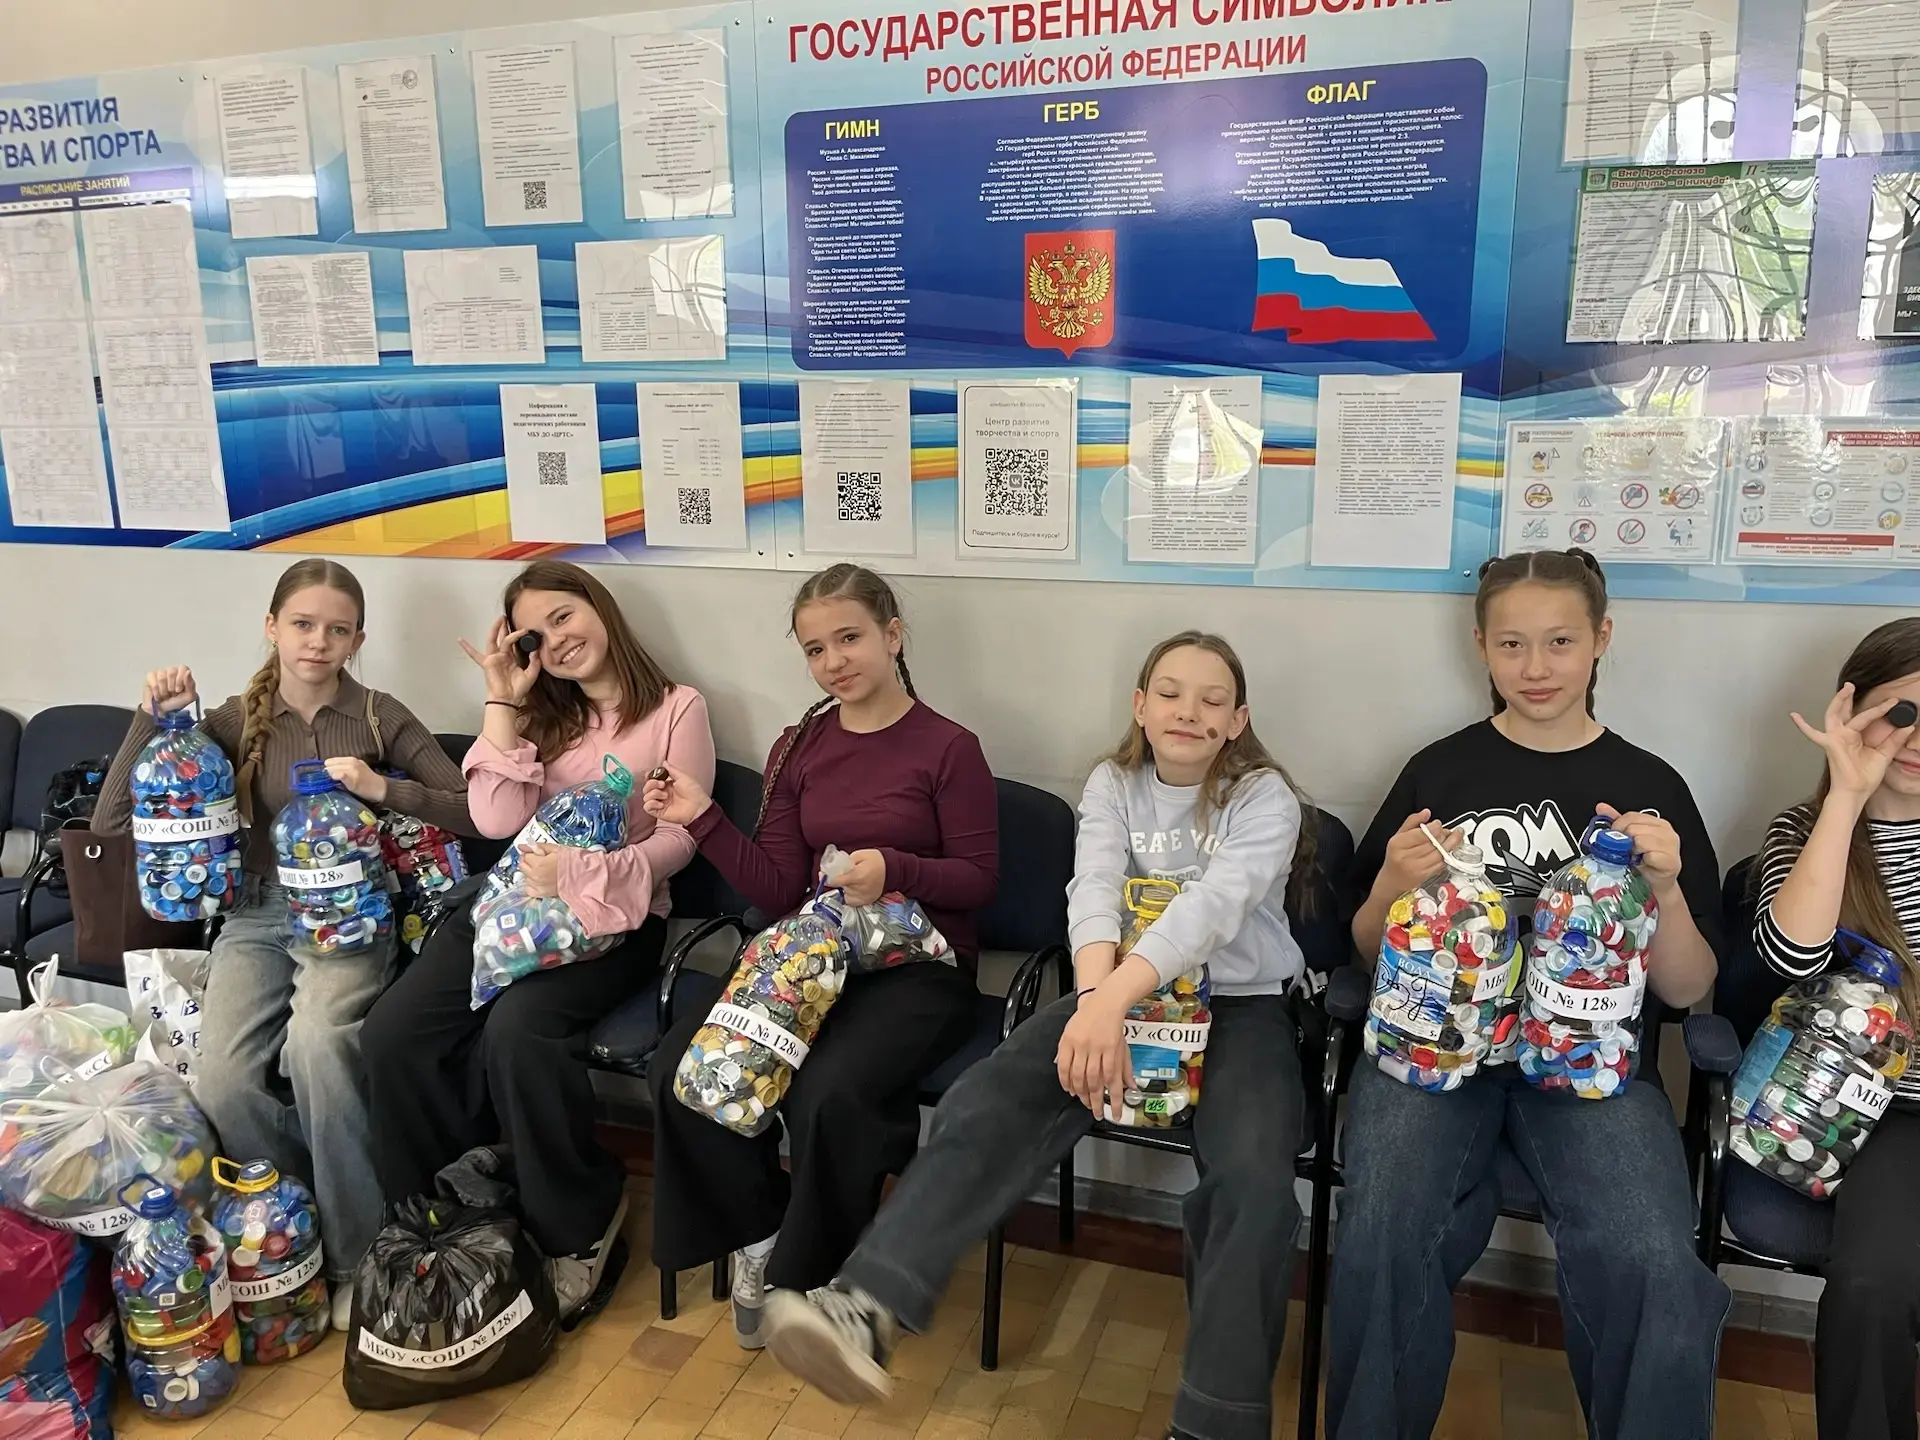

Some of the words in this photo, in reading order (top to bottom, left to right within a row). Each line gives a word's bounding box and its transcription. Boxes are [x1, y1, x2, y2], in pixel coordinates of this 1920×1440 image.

[789, 0, 1176, 62] ГОСУДАРСТВЕННАЯ
[927, 45, 1112, 94] РОССИЙСКОЙ
[1122, 35, 1306, 80] ФЕДЕРАЦИИ
[1307, 80, 1376, 104] ФЛАГ
[0, 97, 119, 134] РАЗВИТИЯ
[1043, 100, 1100, 123] ГЕРБ
[825, 119, 880, 140] ГИМН
[41, 140, 57, 164] И
[64, 129, 162, 162] СПОРТА
[1641, 167, 1706, 179] Профсоюза
[20, 180, 84, 196] РАСПИСАНИЕ
[85, 176, 130, 191] ЗАНЯТИЙ
[985, 417, 1010, 426] Центр
[1012, 418, 1050, 426] развития
[975, 429, 1021, 437] творчества
[1030, 430, 1059, 438] спорта
[161, 819, 212, 835] «СОШ
[216, 815, 229, 830] №
[299, 873, 309, 885] №
[312, 870, 344, 885] 128»
[1553, 990, 1574, 1009] №
[1581, 996, 1617, 1012] 128»
[751, 1024, 770, 1041] №
[773, 1034, 800, 1059] 128»
[1147, 1028, 1201, 1043] «СОШ
[1851, 1083, 1889, 1112] МБО
[78, 1217, 95, 1232] №
[102, 1211, 137, 1230] 128»
[230, 1282, 270, 1297] СОШ
[275, 1275, 293, 1290] №
[296, 1255, 319, 1284] 128»
[365, 1335, 406, 1362] МБОУ
[412, 1345, 466, 1365] «СОШ
[471, 1335, 487, 1351] №
[491, 1310, 517, 1337] 128»
